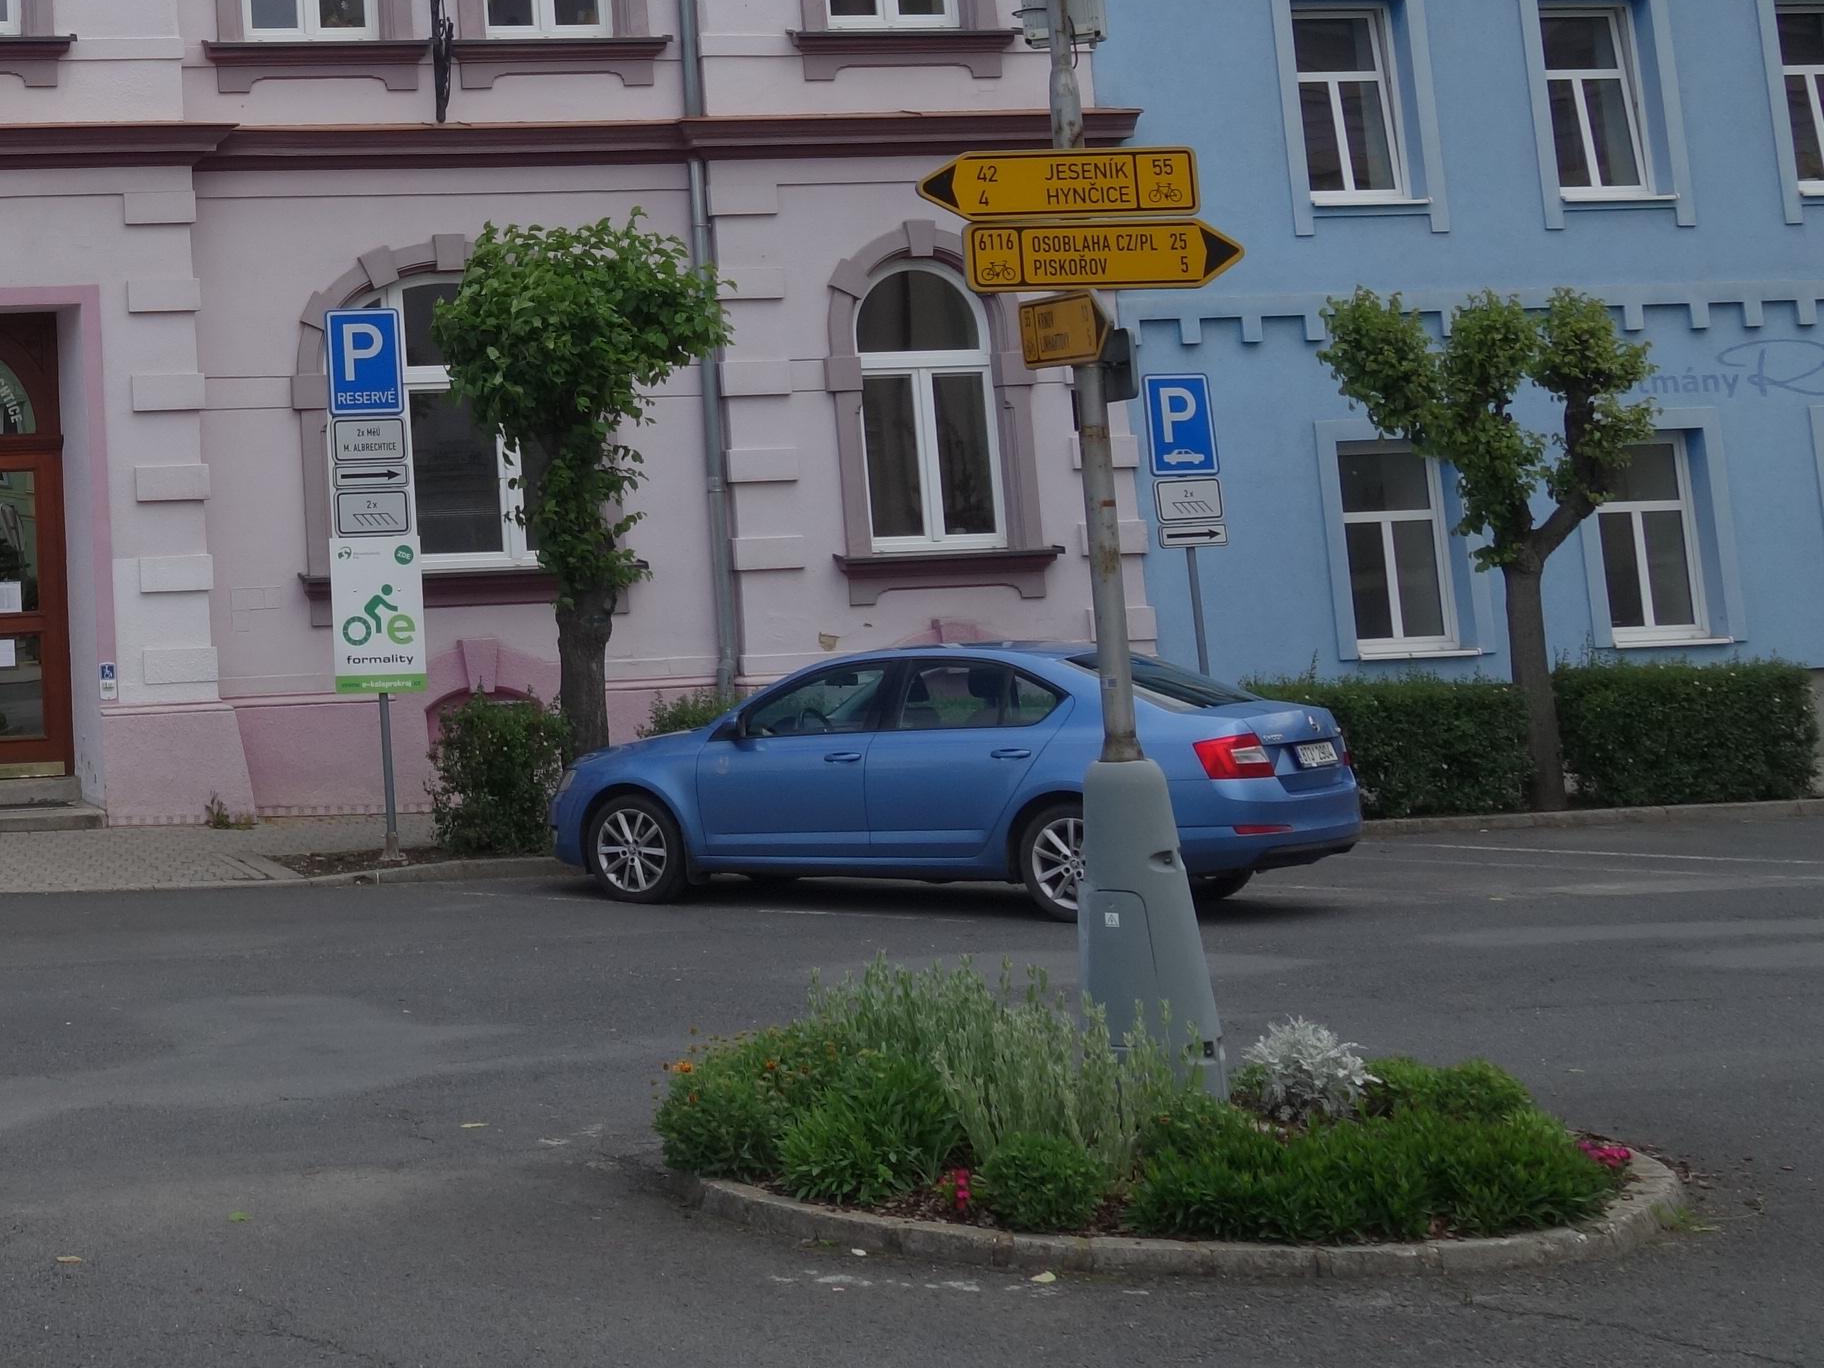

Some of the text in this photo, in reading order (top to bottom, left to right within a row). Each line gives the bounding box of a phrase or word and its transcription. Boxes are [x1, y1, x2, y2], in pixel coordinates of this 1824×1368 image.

[977, 158, 1174, 183] 42 JESENÍK 55
[978, 183, 1131, 207] 4 HYNČICE
[979, 233, 1187, 253] 6116 OSOBLAHA CZ/PL 25
[1033, 254, 1189, 277] PISKOŘOV 5
[342, 323, 383, 381] P
[337, 387, 396, 405] RESERVÉ
[1159, 387, 1197, 444] P
[343, 441, 397, 452] M. ALBRECHTICE
[366, 500, 377, 509] 2x
[395, 550, 412, 561] ZDE
[346, 654, 415, 665] formality
